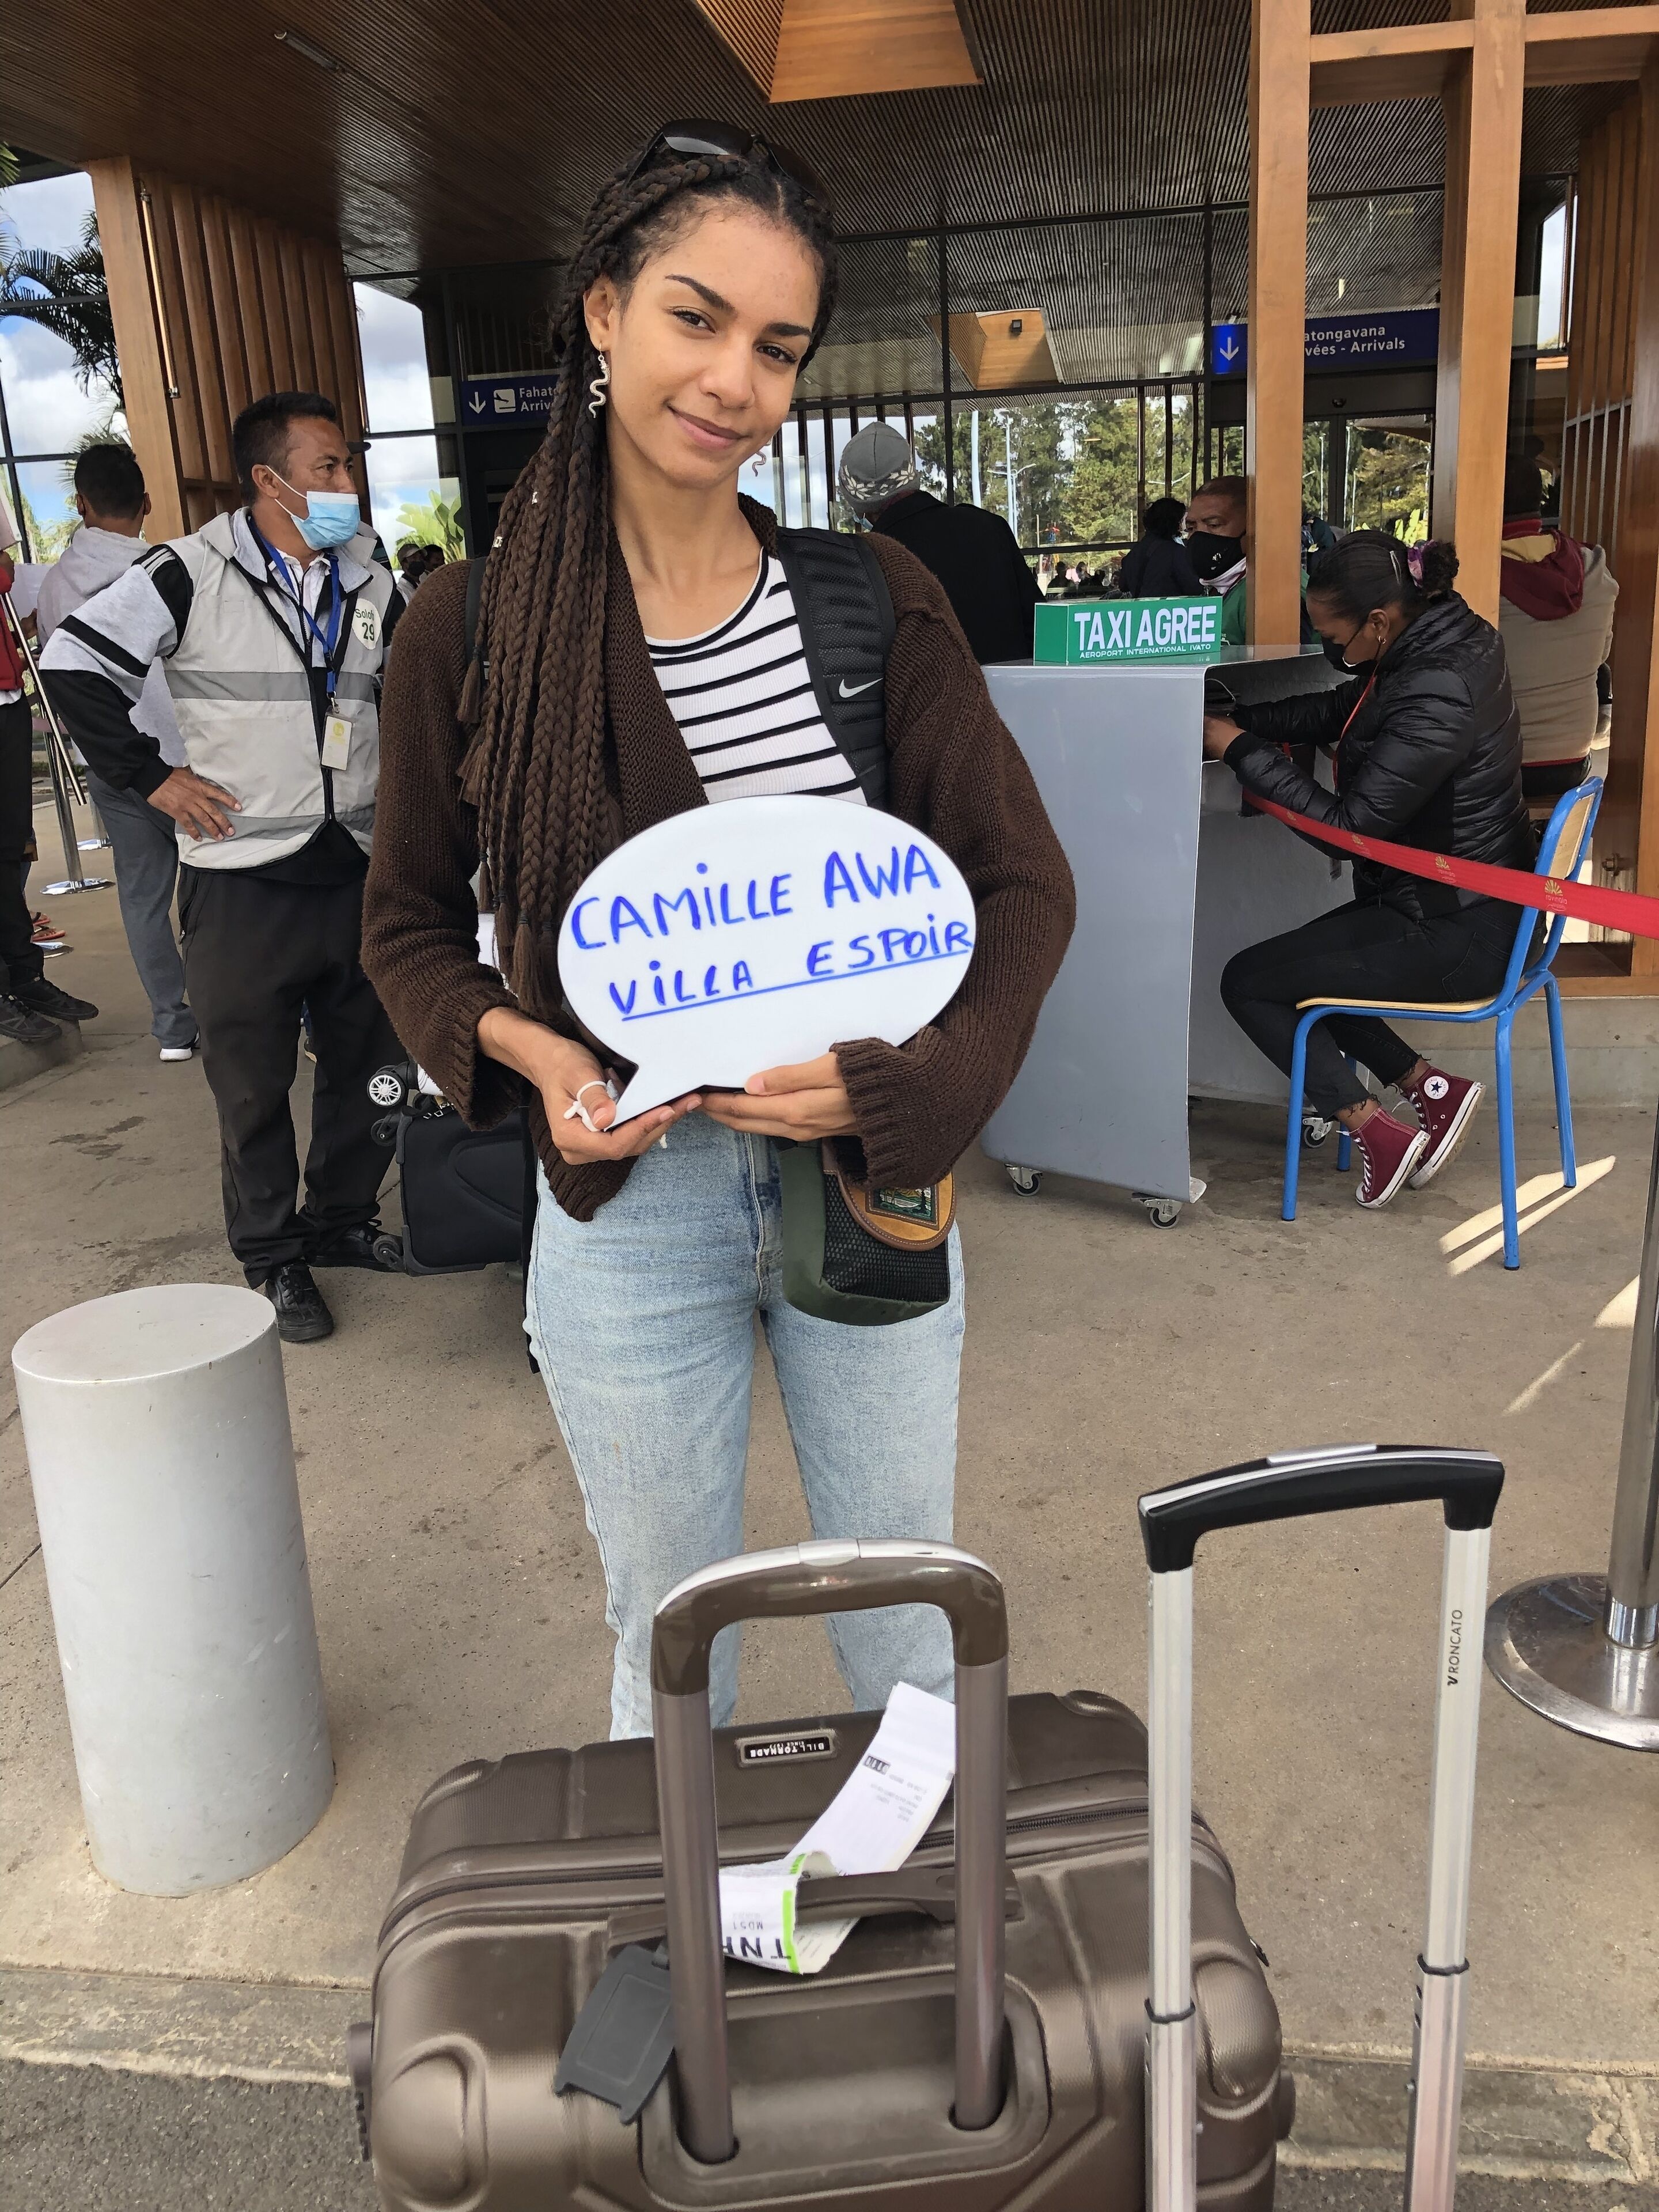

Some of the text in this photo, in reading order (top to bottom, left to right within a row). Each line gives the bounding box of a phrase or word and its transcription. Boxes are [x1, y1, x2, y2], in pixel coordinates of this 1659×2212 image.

[1350, 338, 1406, 353] Arrivals
[362, 622, 374, 641] 29
[1074, 605, 1217, 651] TAXI AGREE
[1080, 649, 1124, 659] AEROPORT
[1126, 645, 1187, 656] INTERNATIONAL
[824, 844, 940, 908] AWA
[1448, 1609, 1463, 1674] RONCATO
[801, 1742, 825, 1752] BILL
